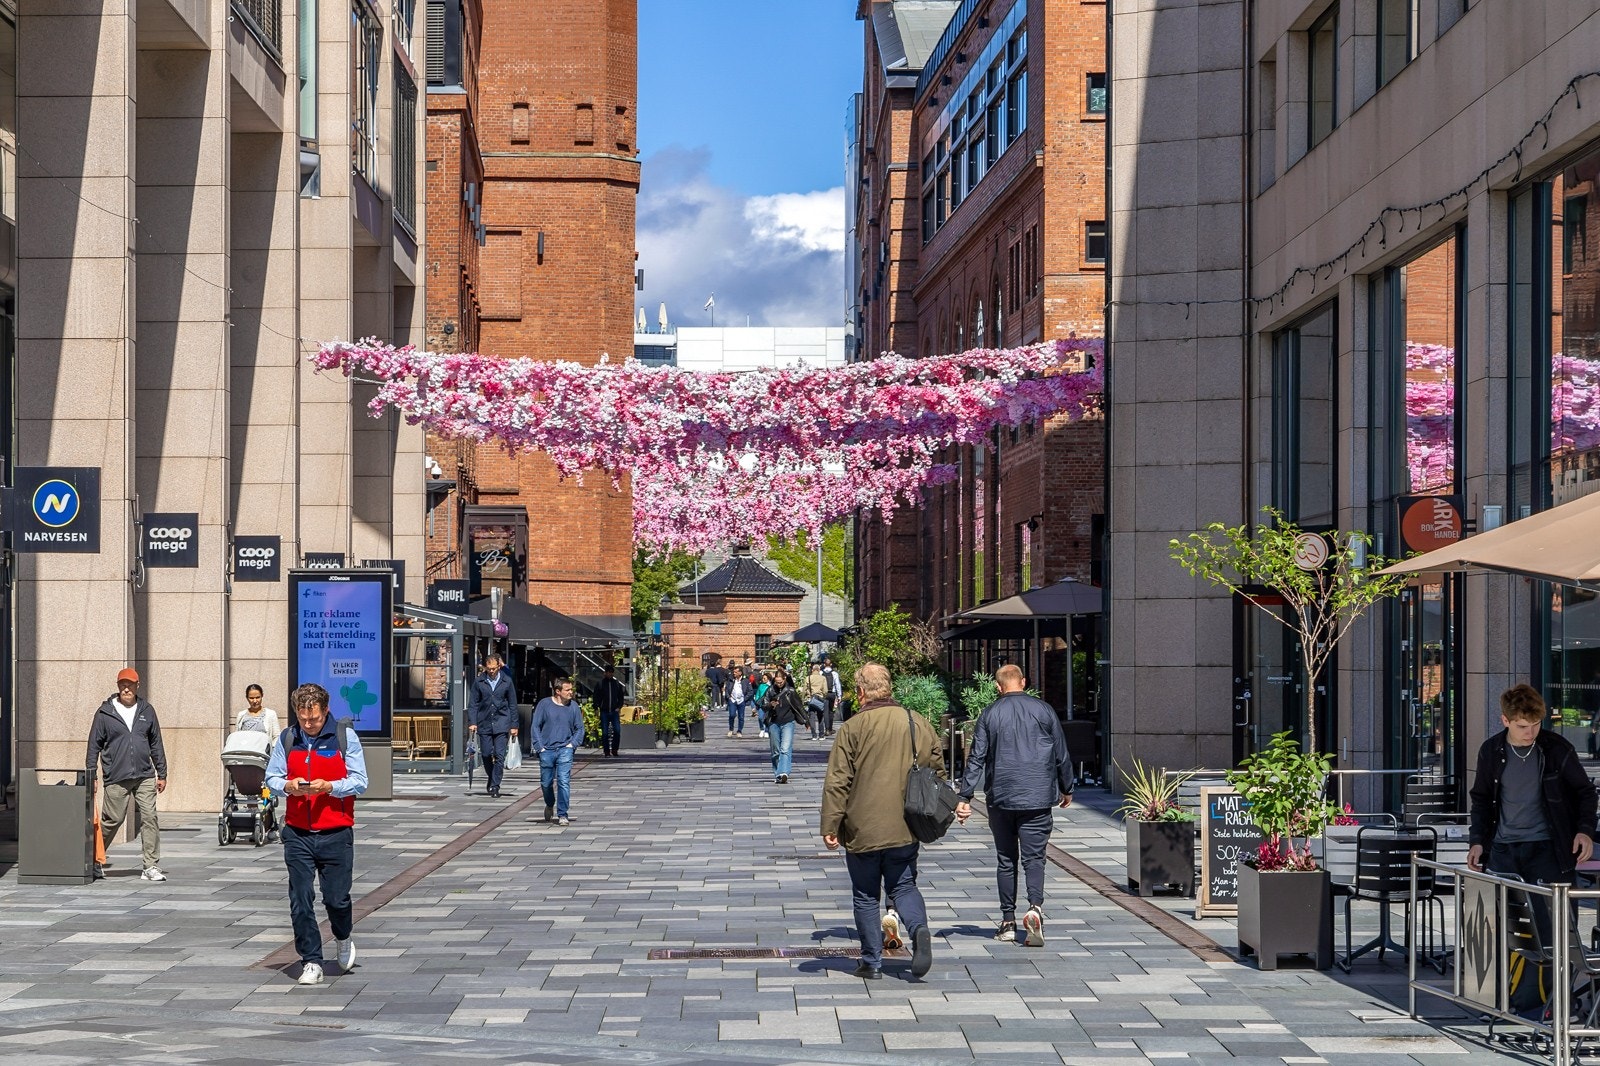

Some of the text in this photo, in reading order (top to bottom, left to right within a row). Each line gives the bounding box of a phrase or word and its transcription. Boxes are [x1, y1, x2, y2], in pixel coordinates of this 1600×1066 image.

[1434, 498, 1453, 531] ARK
[24, 532, 88, 542] NARVESEN
[149, 527, 192, 541] coop
[149, 541, 187, 553] mega
[239, 547, 275, 559] coop
[239, 559, 271, 570] mega
[437, 589, 465, 601] SHUFL
[303, 609, 361, 618] En reklame
[303, 620, 361, 629] for å levere
[303, 630, 376, 642] skattemelding
[303, 640, 356, 649] med Fiken
[1217, 796, 1242, 811] MAT
